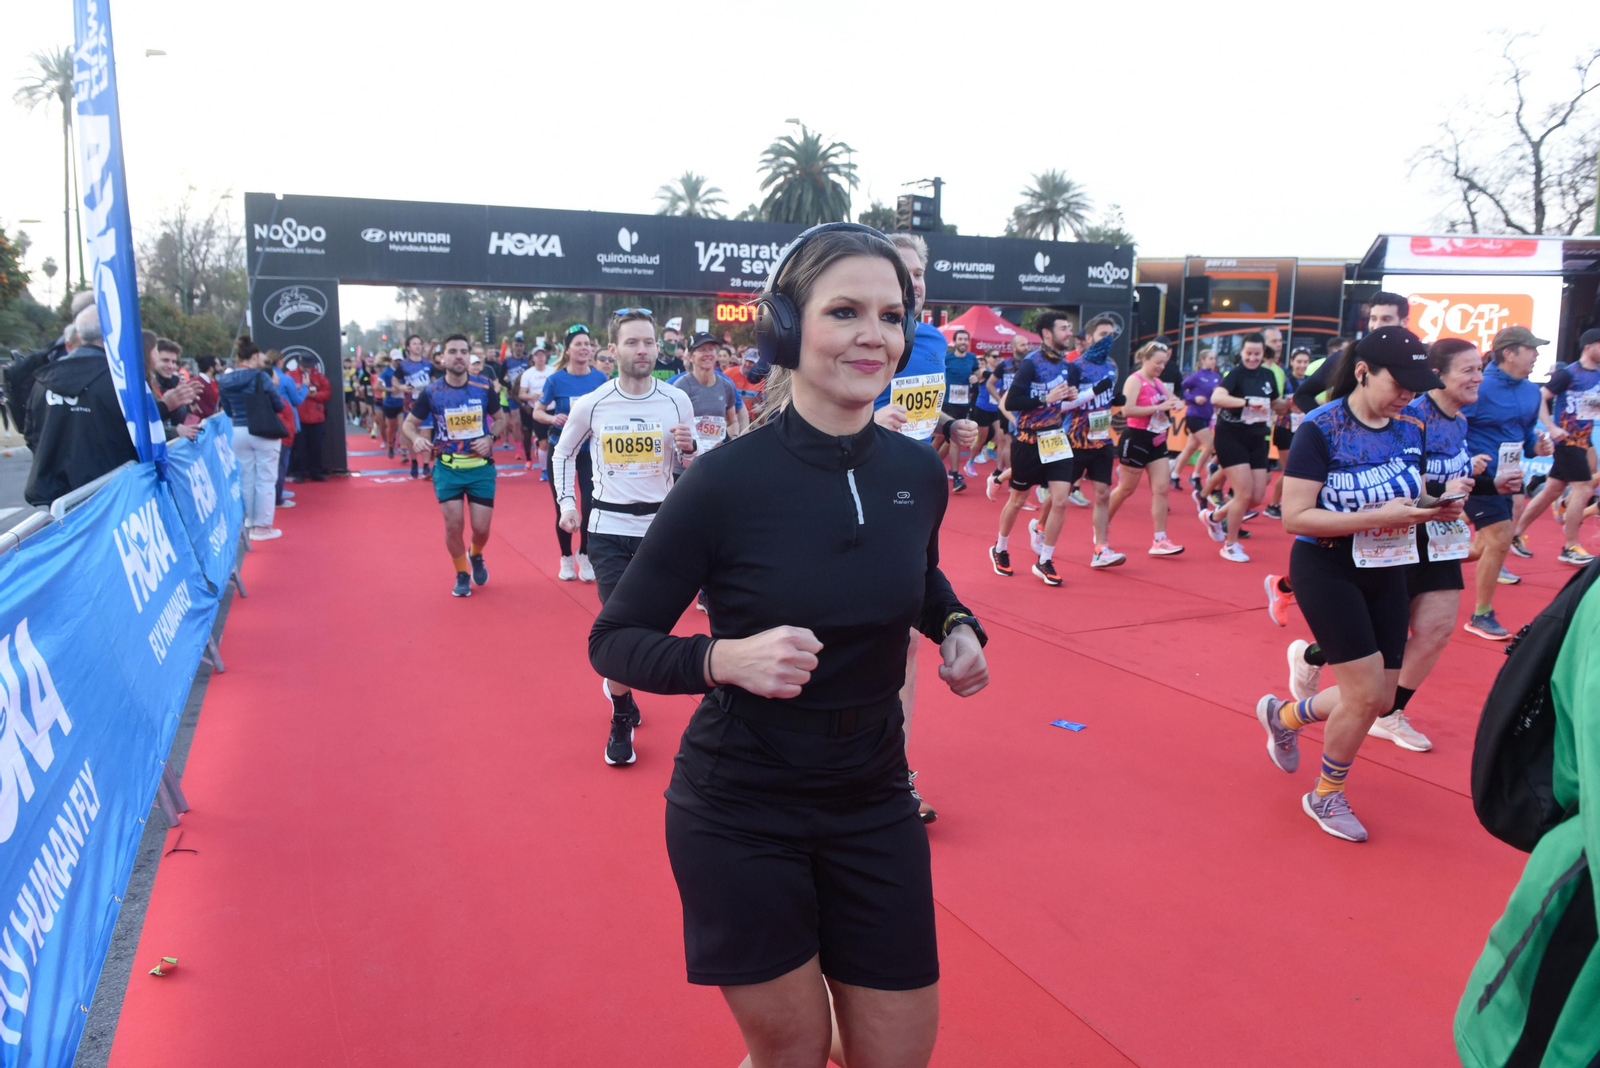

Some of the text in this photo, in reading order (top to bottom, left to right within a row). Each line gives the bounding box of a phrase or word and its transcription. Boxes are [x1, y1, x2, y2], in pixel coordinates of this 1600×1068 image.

[388, 230, 451, 244] HYUNDAI
[488, 231, 564, 258] HOKA
[602, 266, 654, 275] Healthcare Partner
[952, 262, 995, 273] HYUNDAI
[730, 278, 741, 287] 28
[896, 390, 939, 412] 10957
[606, 436, 654, 454] 10859
[112, 496, 178, 615] HOKA
[8, 801, 85, 967] HUMAN
[68, 757, 101, 836] FLY
